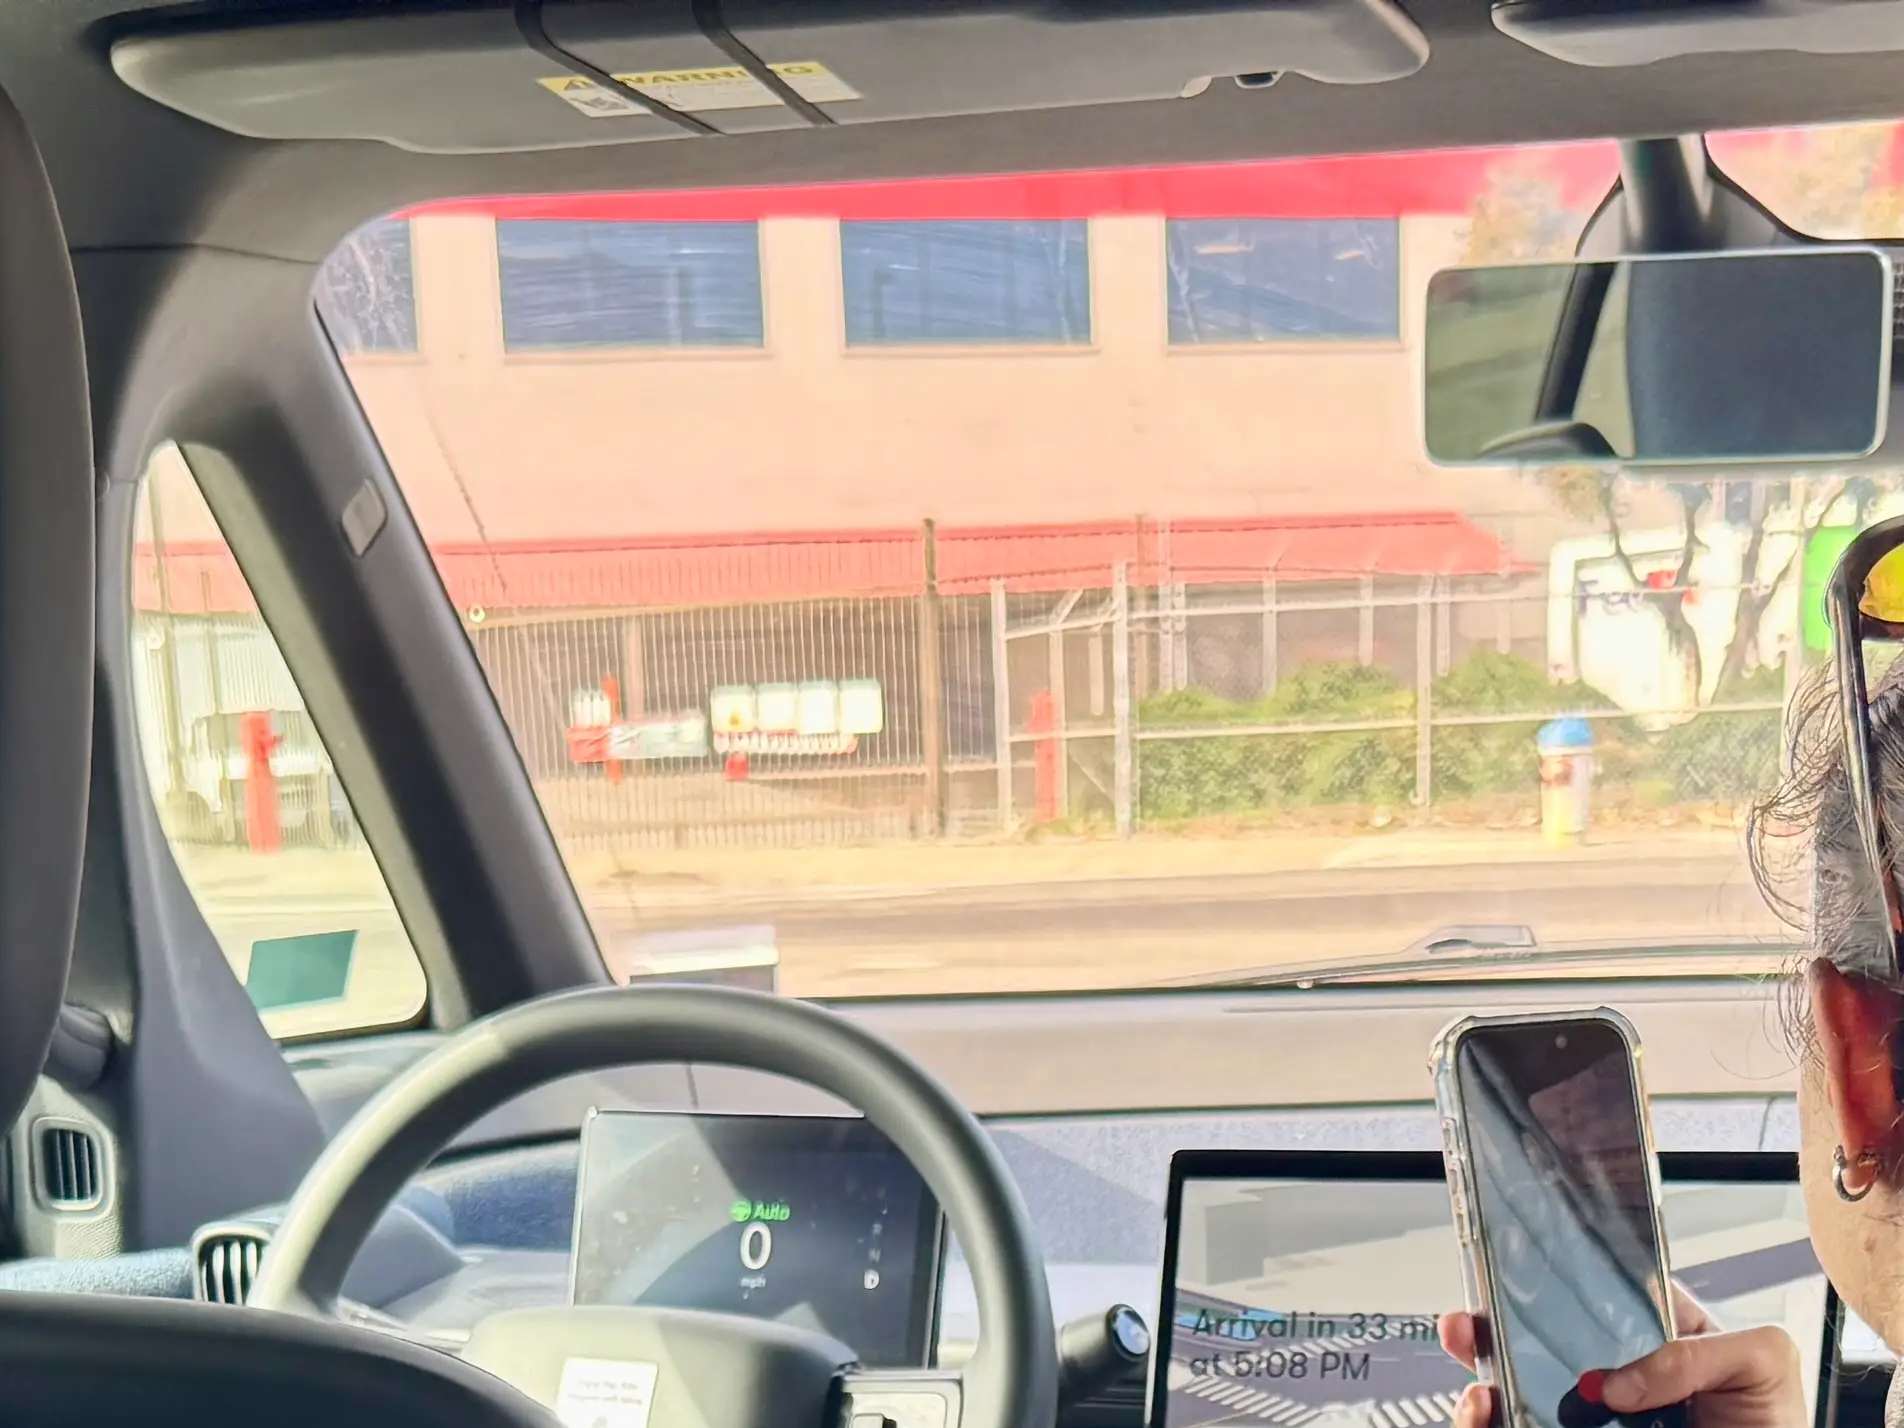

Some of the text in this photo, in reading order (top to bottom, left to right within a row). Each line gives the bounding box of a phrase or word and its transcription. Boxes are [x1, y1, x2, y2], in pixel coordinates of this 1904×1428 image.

[617, 65, 813, 84] WARNIG
[754, 1202, 791, 1221] Auto
[740, 1221, 772, 1270] 0
[863, 1269, 880, 1290] D
[1192, 1308, 1440, 1342] Arrival in 33 mi
[1189, 1350, 1371, 1381] at 5:08 PM
